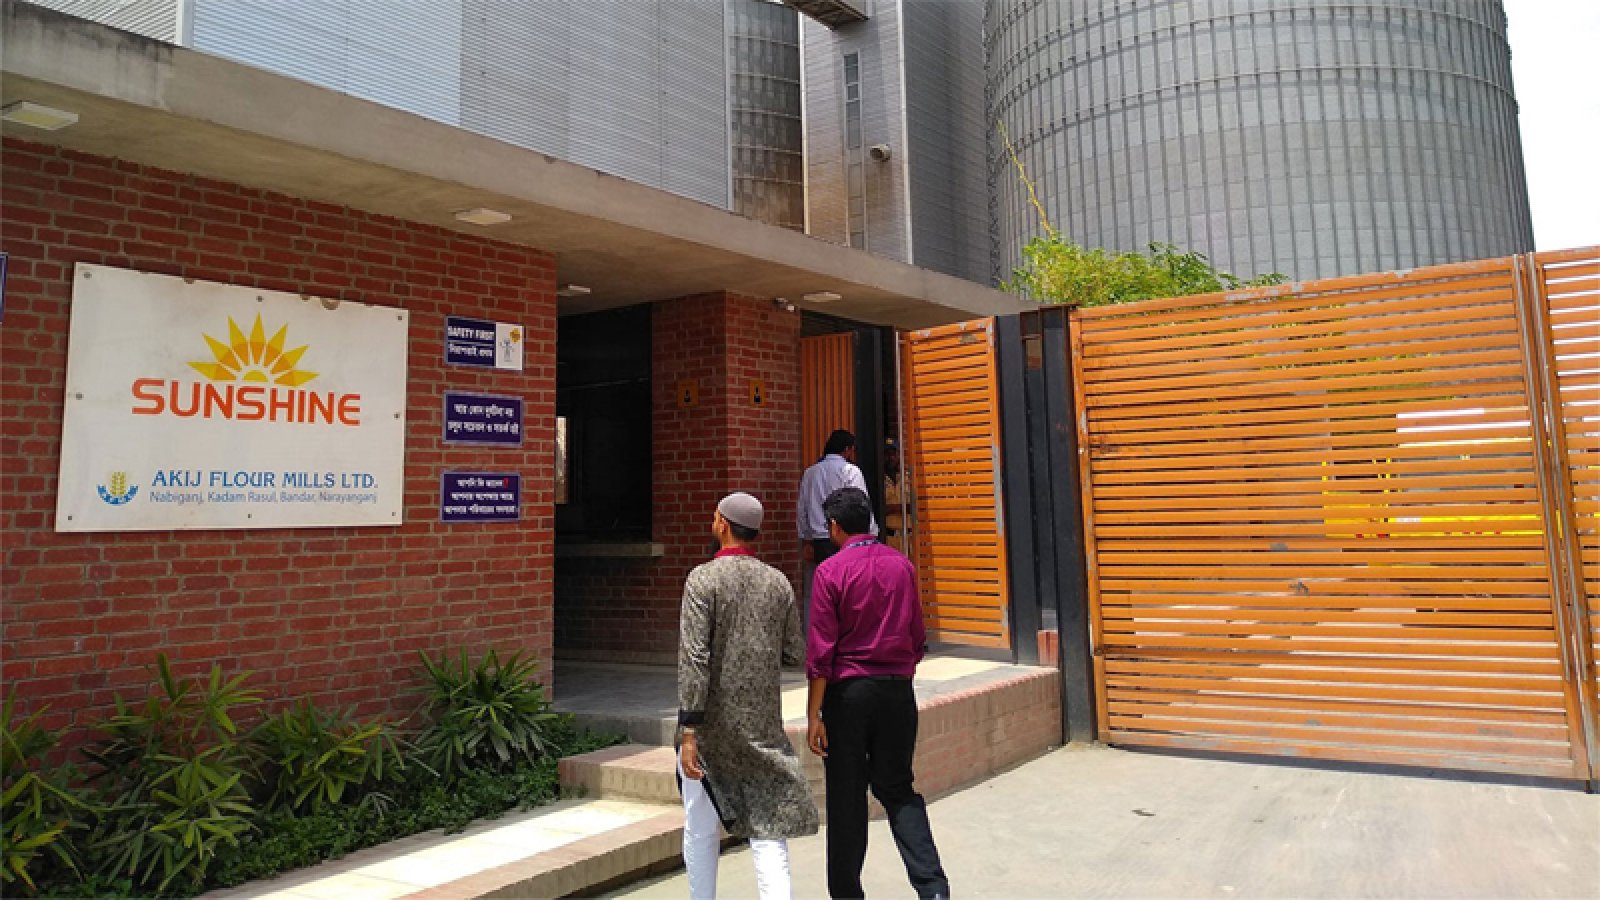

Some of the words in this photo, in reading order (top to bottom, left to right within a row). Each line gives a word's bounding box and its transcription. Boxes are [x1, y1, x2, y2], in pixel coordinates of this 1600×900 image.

[131, 377, 361, 427] SUNSHINE
[151, 469, 202, 487] AKIJ
[208, 470, 275, 488] FLOUR
[281, 471, 336, 489] MILLS
[341, 472, 379, 489] LTD.
[207, 491, 247, 503] Kadam
[318, 492, 377, 505] Narayanganj
